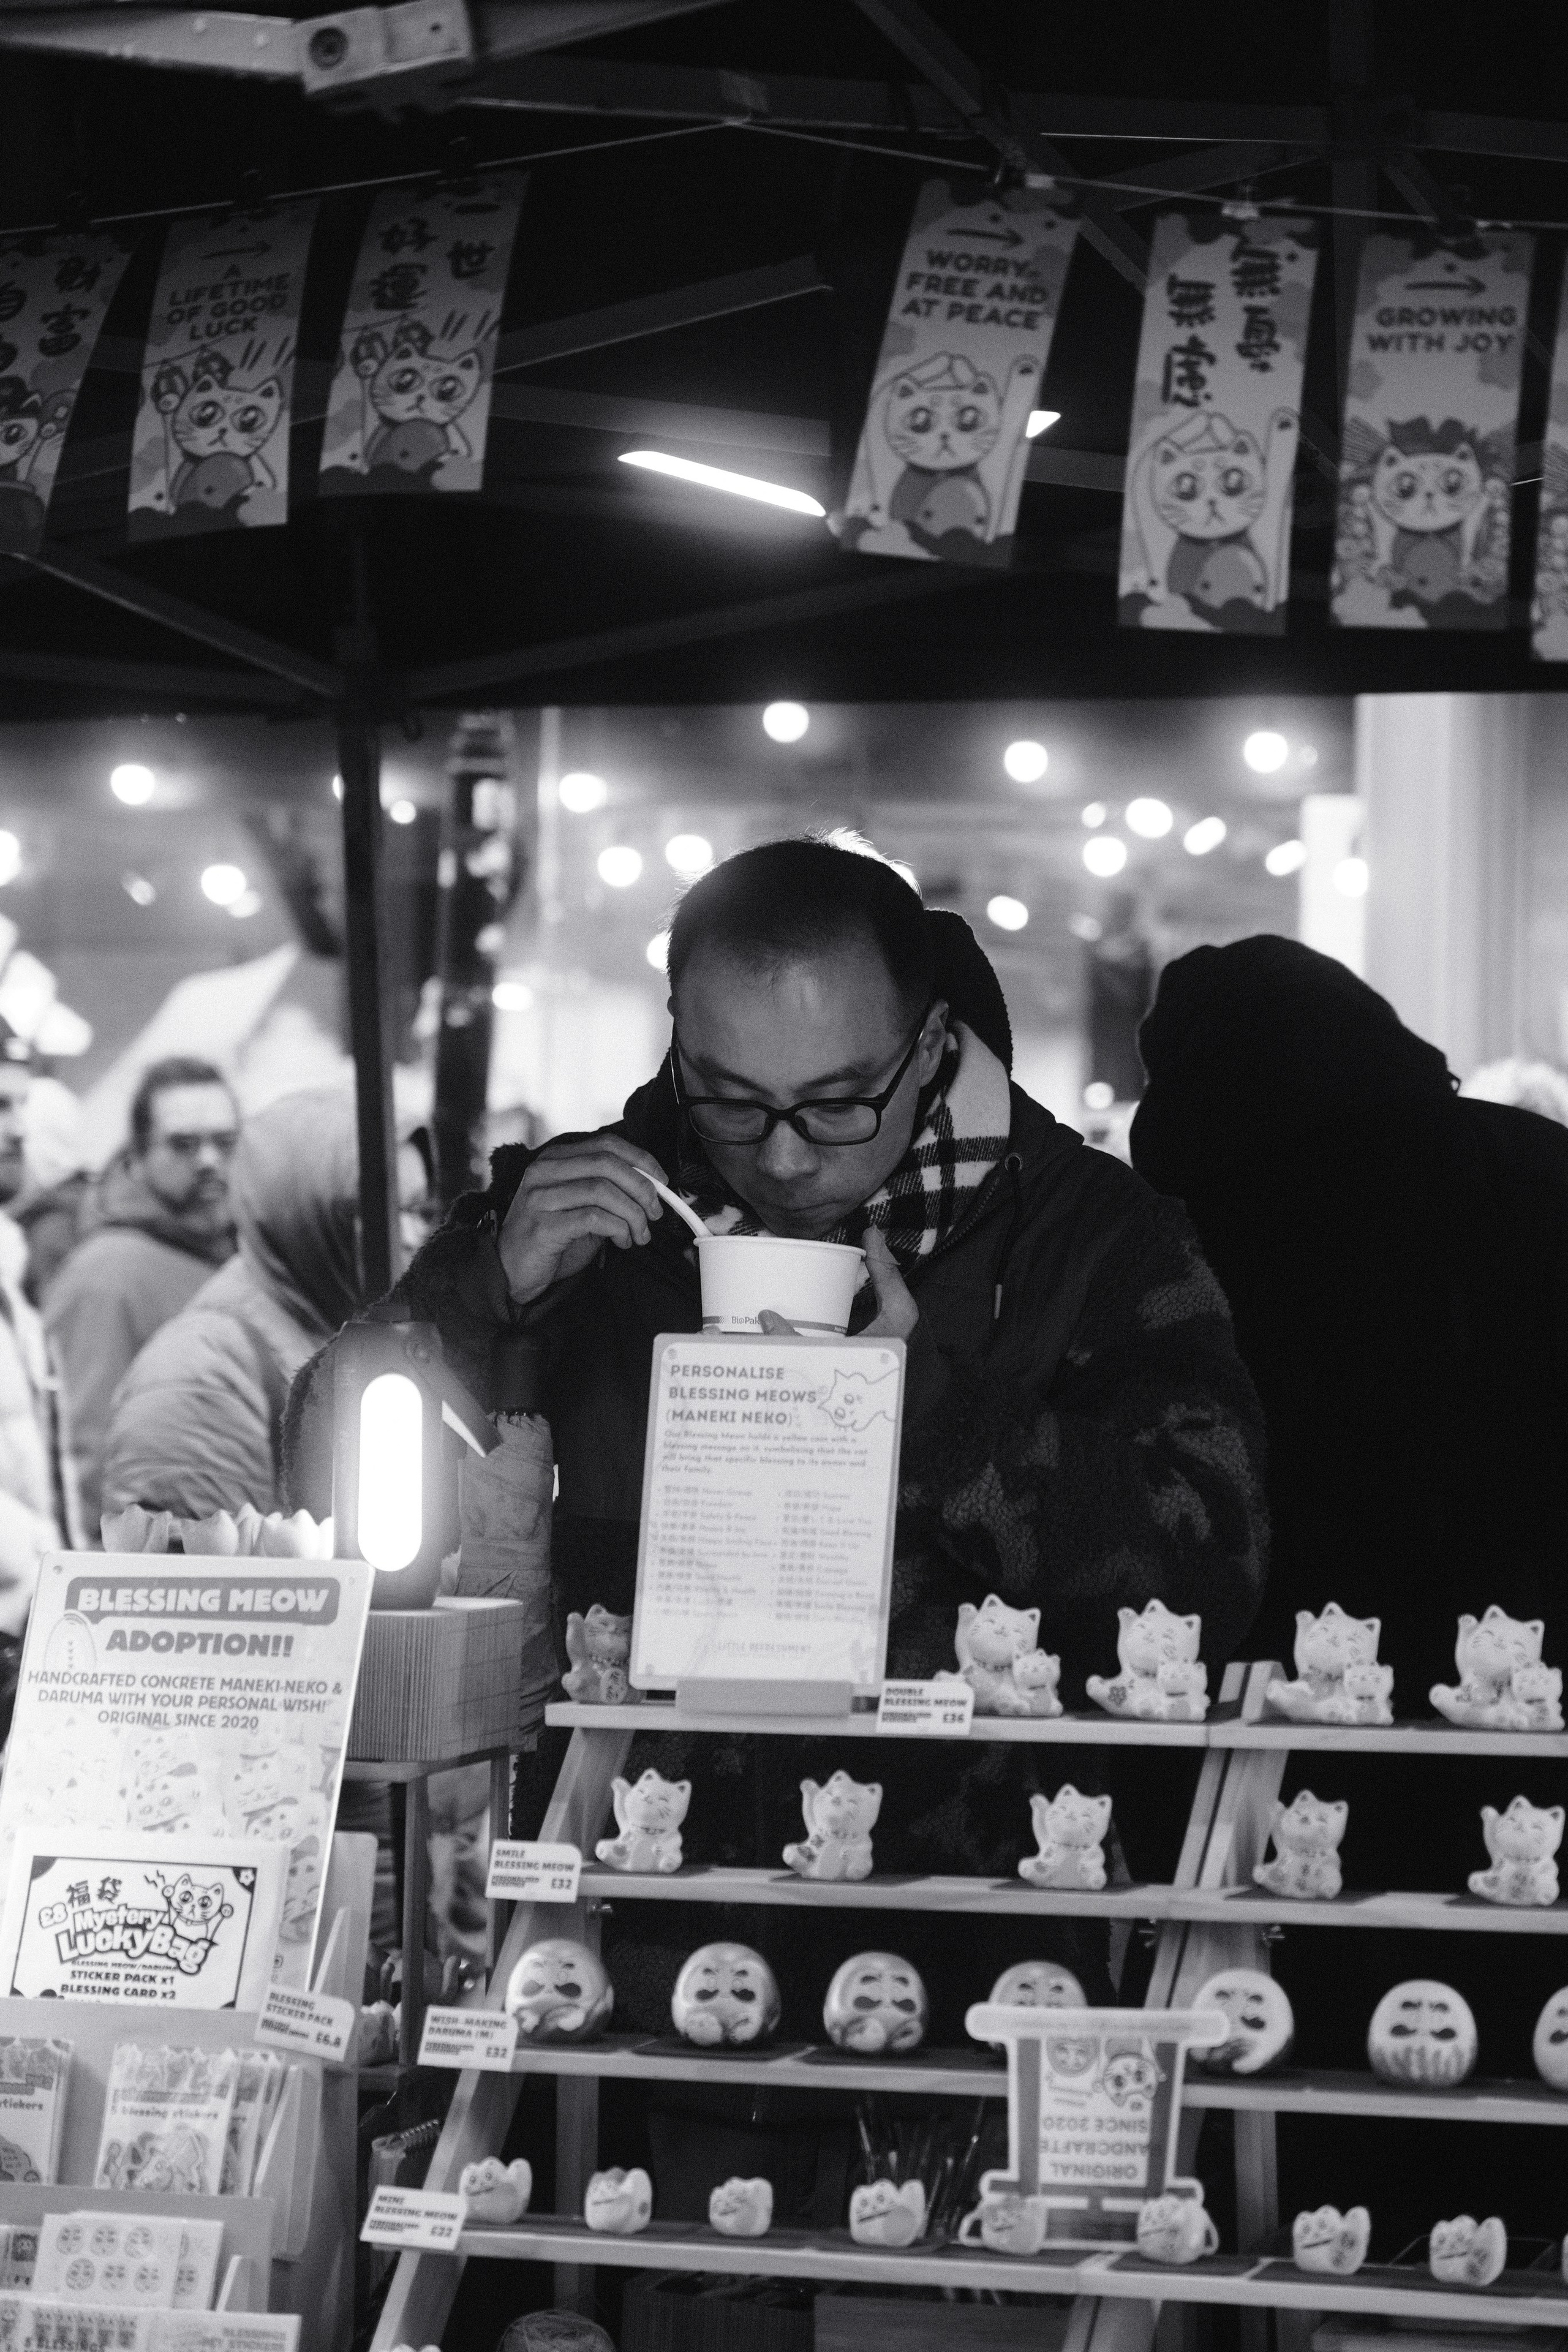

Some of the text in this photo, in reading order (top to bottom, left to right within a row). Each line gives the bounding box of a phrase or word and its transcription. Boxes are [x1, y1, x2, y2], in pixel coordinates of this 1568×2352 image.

[224, 263, 241, 279] A
[169, 273, 290, 306] LIFETIME
[905, 271, 1049, 304] FREE AND
[166, 292, 288, 326] OF GOOD
[901, 298, 1041, 330] AT PEACE
[1376, 307, 1518, 328] GROWING
[189, 316, 257, 341] LUCK
[1366, 332, 1515, 353] WITH JOY
[671, 1365, 785, 1379] PERSONALISE
[669, 1386, 817, 1403] BLESSING MEOWS
[666, 1409, 792, 1427] (MANEKI NEKO)
[77, 1588, 330, 1613] BLESSING MEOW
[105, 1629, 294, 1657] ADOPTION!!
[28, 1671, 342, 1695] HANDCRAFTED CONCRETE MANEKI-NEKO &
[37, 1690, 104, 1705] DARUMA
[108, 1692, 146, 1706] WITH
[151, 1694, 194, 1709] YOUR
[197, 1696, 278, 1712] PERSONAL
[933, 1699, 968, 1708] MEOW
[97, 1711, 259, 1730] ORIGINAL SINCE 2020
[494, 1860, 575, 1872] BLESSING MEOW
[66, 1876, 123, 1908] 福袋
[39, 1902, 69, 1929] £8
[73, 1903, 172, 1932] Mystery
[70, 1970, 175, 1985] STICKER PACK x1
[61, 1984, 176, 2000] BLESSING CARD x2
[269, 1992, 315, 2010] BLESSING
[266, 2002, 333, 2027] STICKER PACK
[428, 2026, 472, 2037] DARUMA
[1042, 2116, 1149, 2134] SINCE 2020
[1050, 2162, 1138, 2180] ORIGINAL
[378, 2195, 405, 2204] MINI
[374, 2206, 458, 2220] BLESSING MEOW
